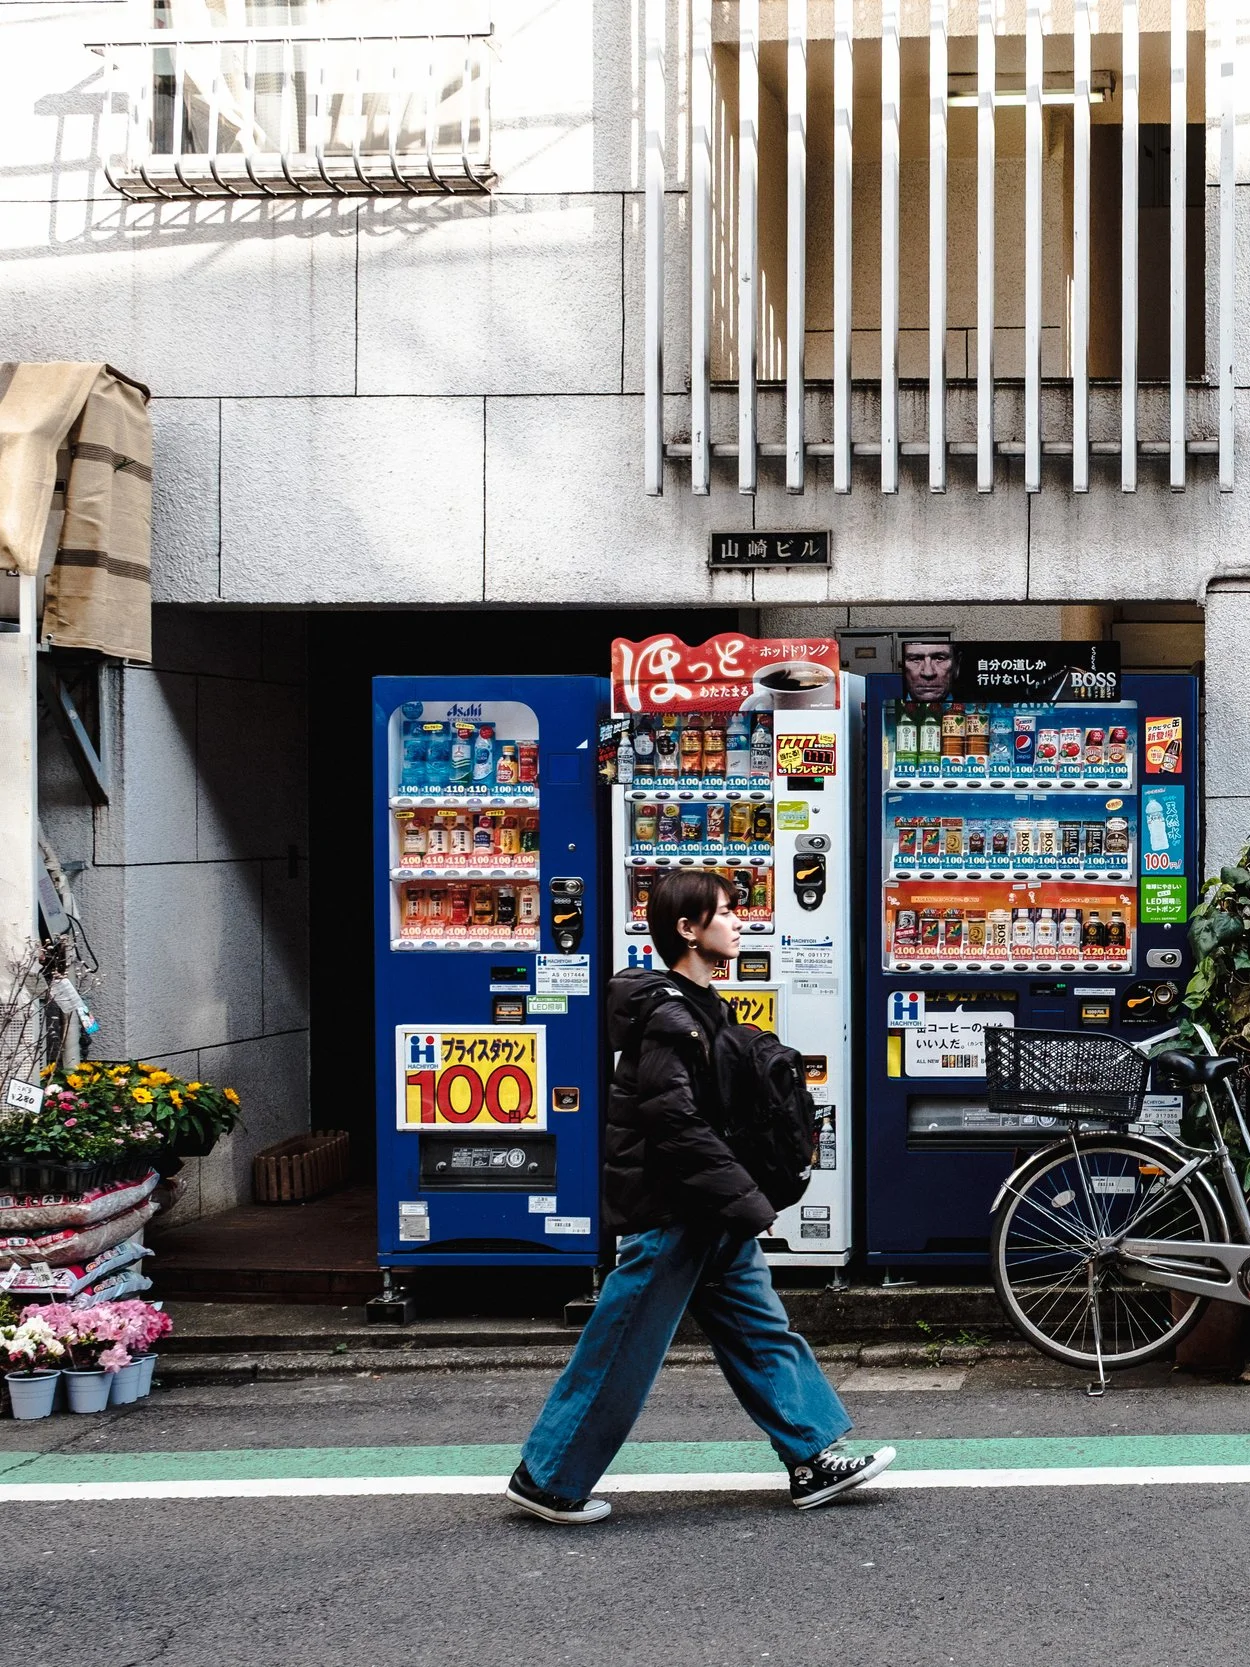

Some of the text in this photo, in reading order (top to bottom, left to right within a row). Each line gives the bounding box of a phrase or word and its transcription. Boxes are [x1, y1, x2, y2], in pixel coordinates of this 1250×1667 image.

[721, 539, 821, 558] 山崎ビル
[760, 645, 830, 658] ホットドリンク
[977, 659, 1046, 671] 自分の道しか
[619, 637, 746, 712] ほっと
[1071, 672, 1117, 687] BOSS
[700, 685, 749, 698] あたたまる
[446, 703, 482, 717] Asahi
[778, 736, 816, 749] 7777
[1022, 832, 1030, 855] BOS
[1045, 832, 1053, 855] BOS
[1069, 830, 1077, 855] BLAC
[1093, 830, 1101, 855] BLAC
[998, 923, 1006, 947] BOS
[916, 1038, 965, 1050] いい人だ。
